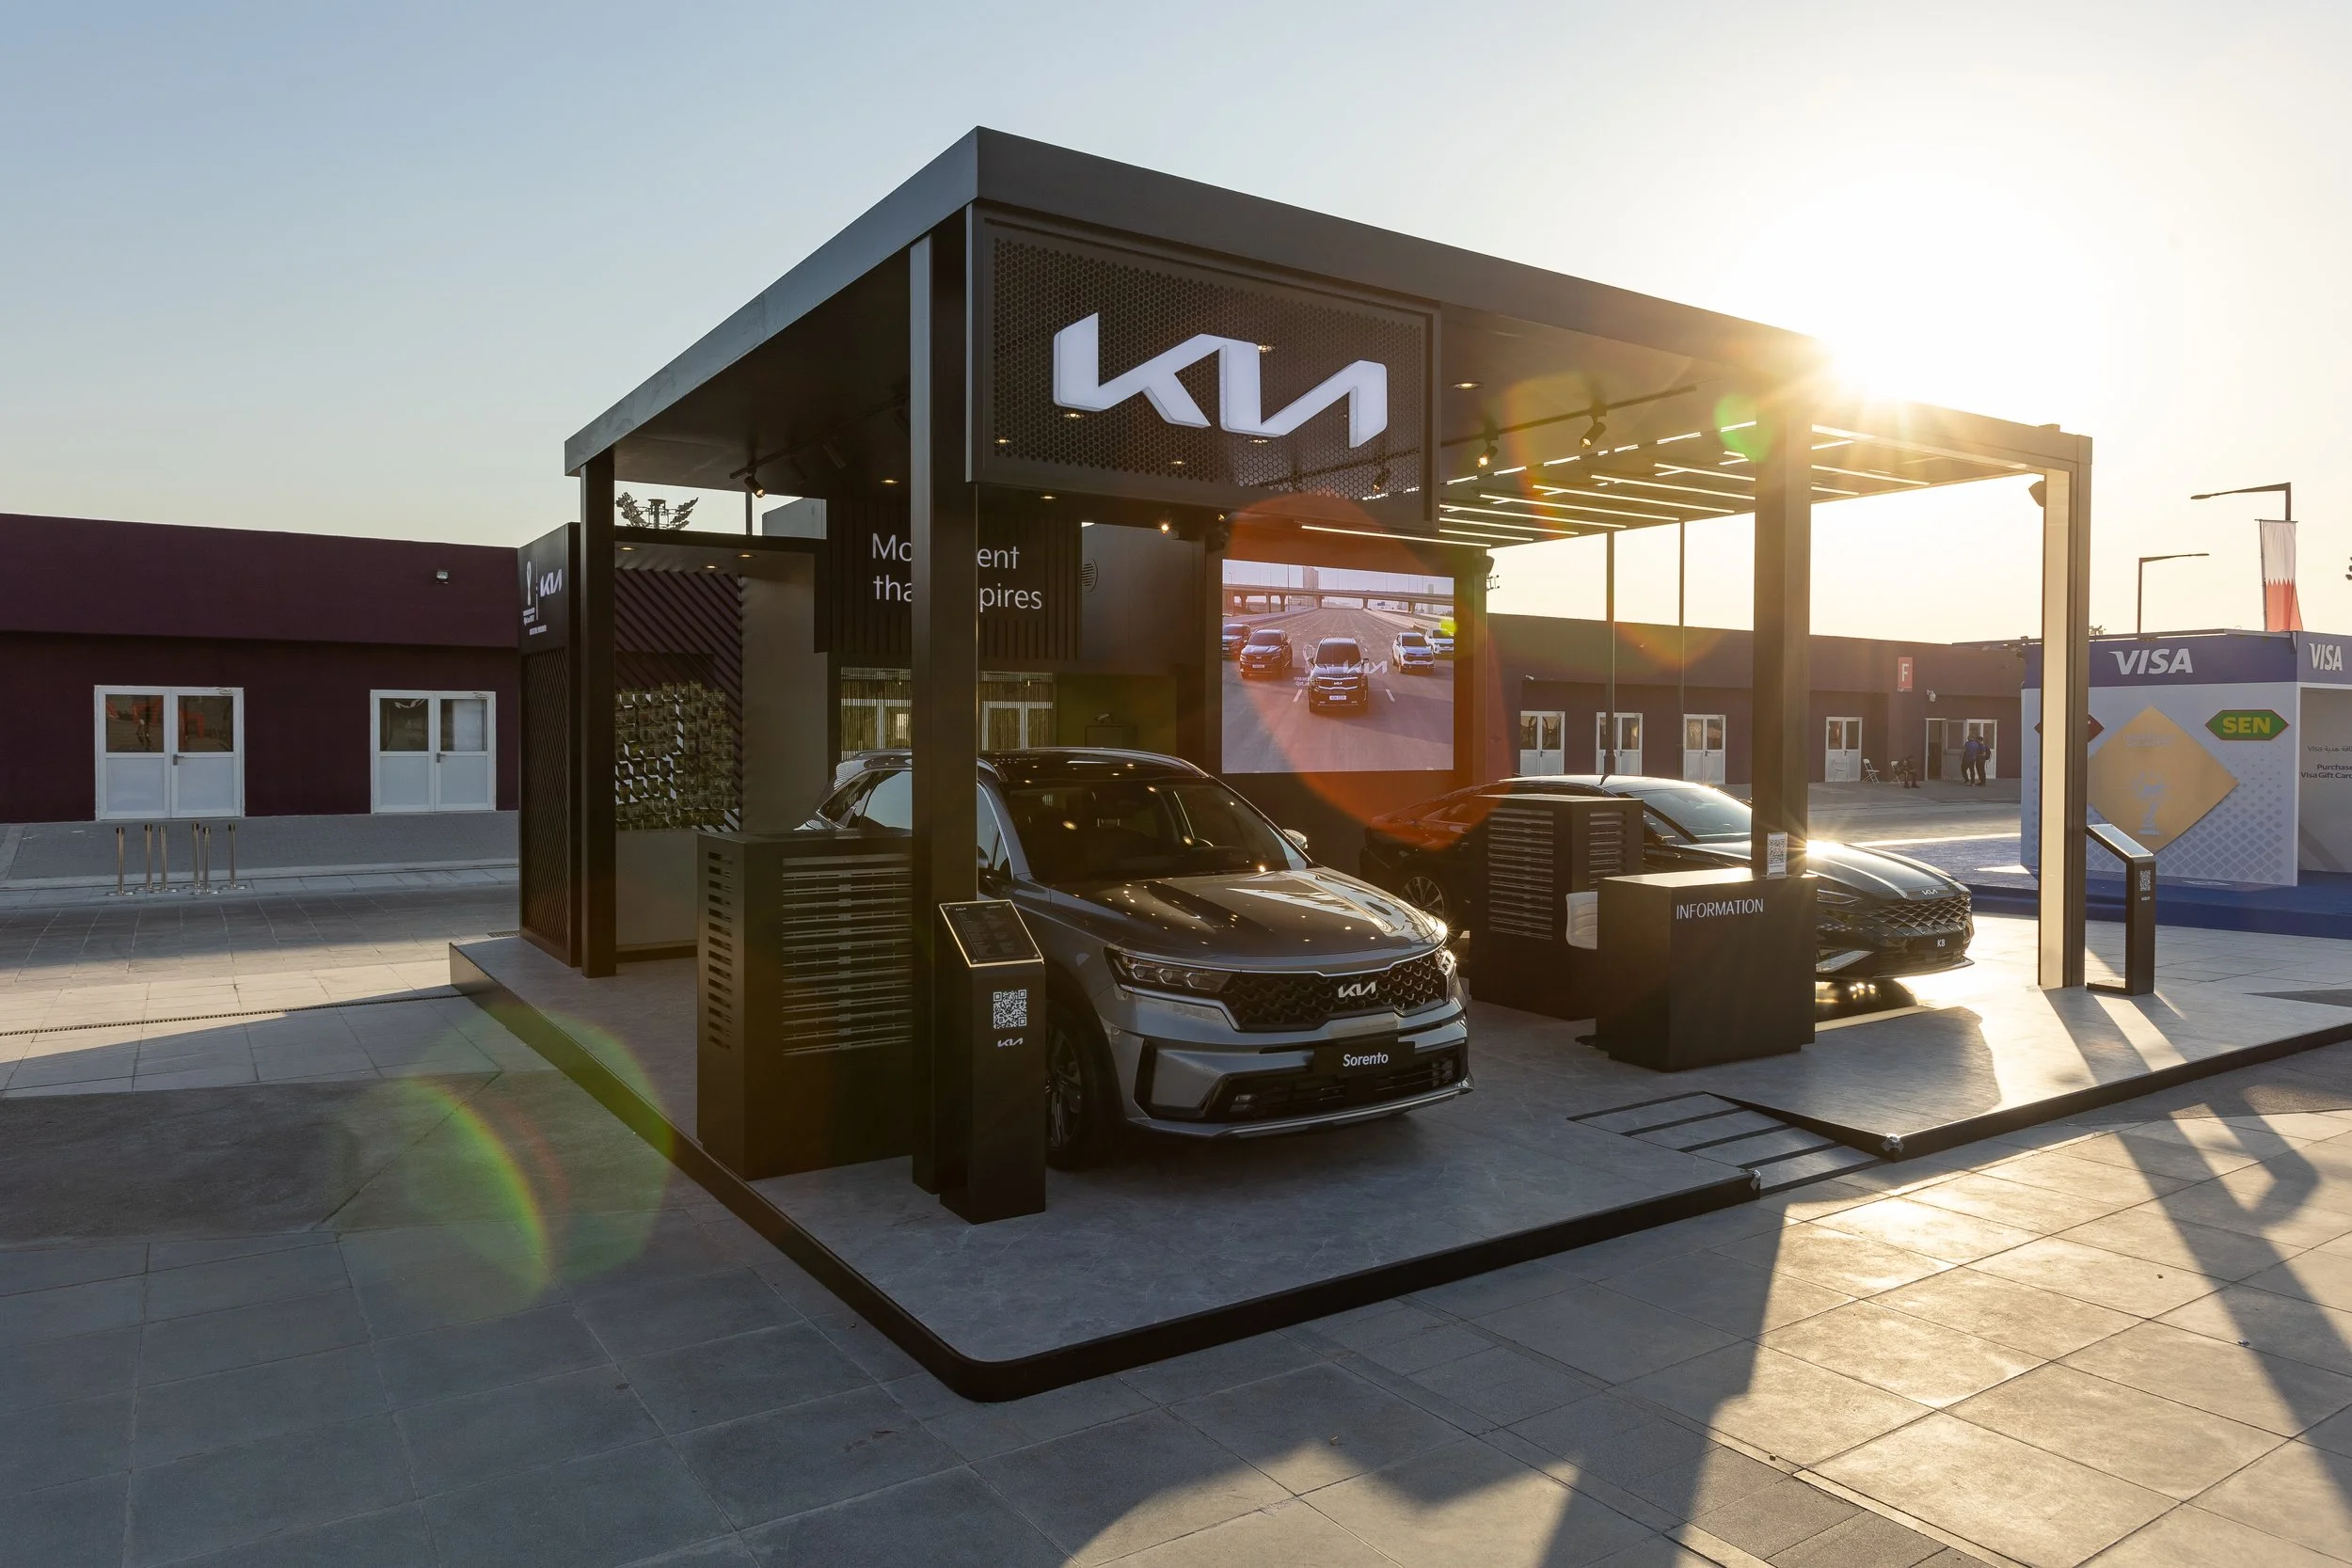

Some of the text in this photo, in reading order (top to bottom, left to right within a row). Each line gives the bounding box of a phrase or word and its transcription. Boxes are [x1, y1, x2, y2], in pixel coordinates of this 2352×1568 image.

[1053, 311, 1388, 449] KIA
[872, 532, 1020, 570] Moent
[540, 568, 563, 597] KIA
[2108, 647, 2194, 675] VISA
[2308, 642, 2343, 672] VISA
[1901, 663, 1910, 682] F
[2221, 717, 2271, 734] SEN
[1677, 898, 1764, 920] INFORMATION
[1937, 939, 1946, 947] K8
[1338, 981, 1376, 998] KIA
[997, 1037, 1024, 1048] KIA
[1343, 1052, 1389, 1068] Sorento
